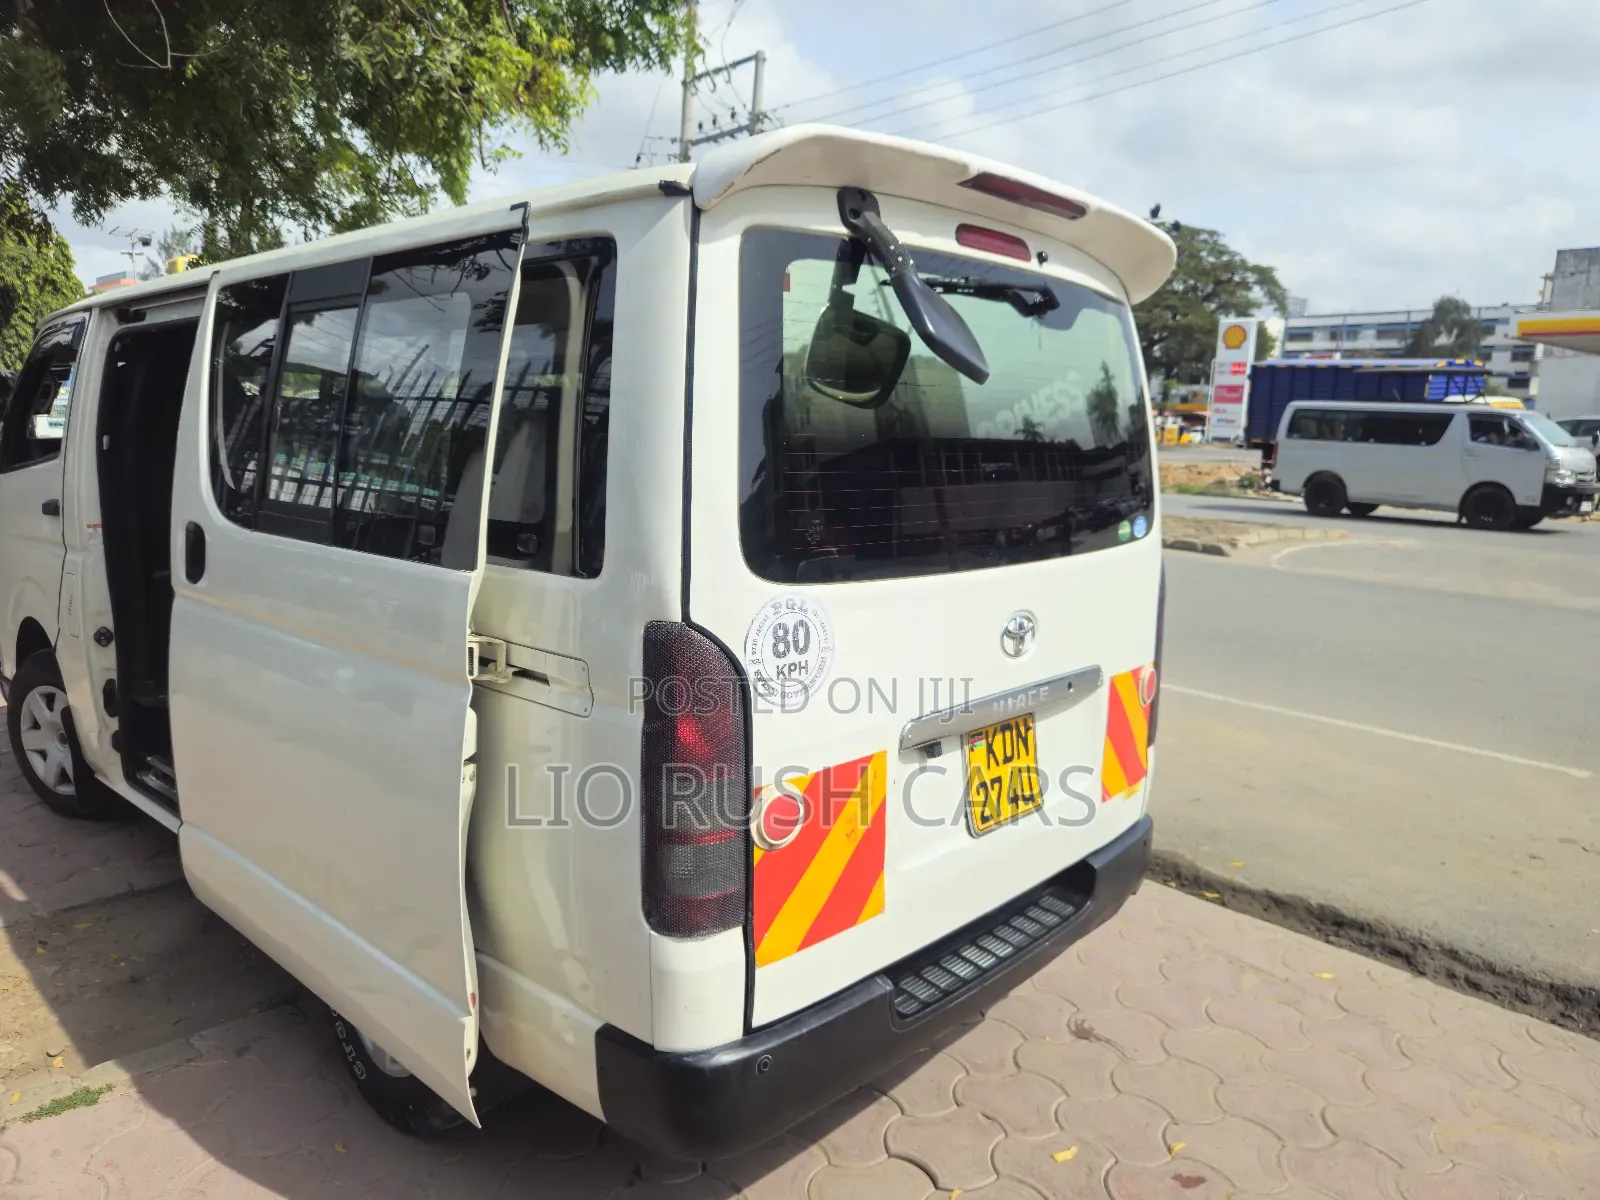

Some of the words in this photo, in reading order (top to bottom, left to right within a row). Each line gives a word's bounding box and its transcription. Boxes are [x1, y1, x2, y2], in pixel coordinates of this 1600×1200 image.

[772, 619, 811, 659] 80
[776, 660, 809, 681] KPH
[985, 717, 1031, 771] KDN
[976, 764, 1036, 825] 274U
